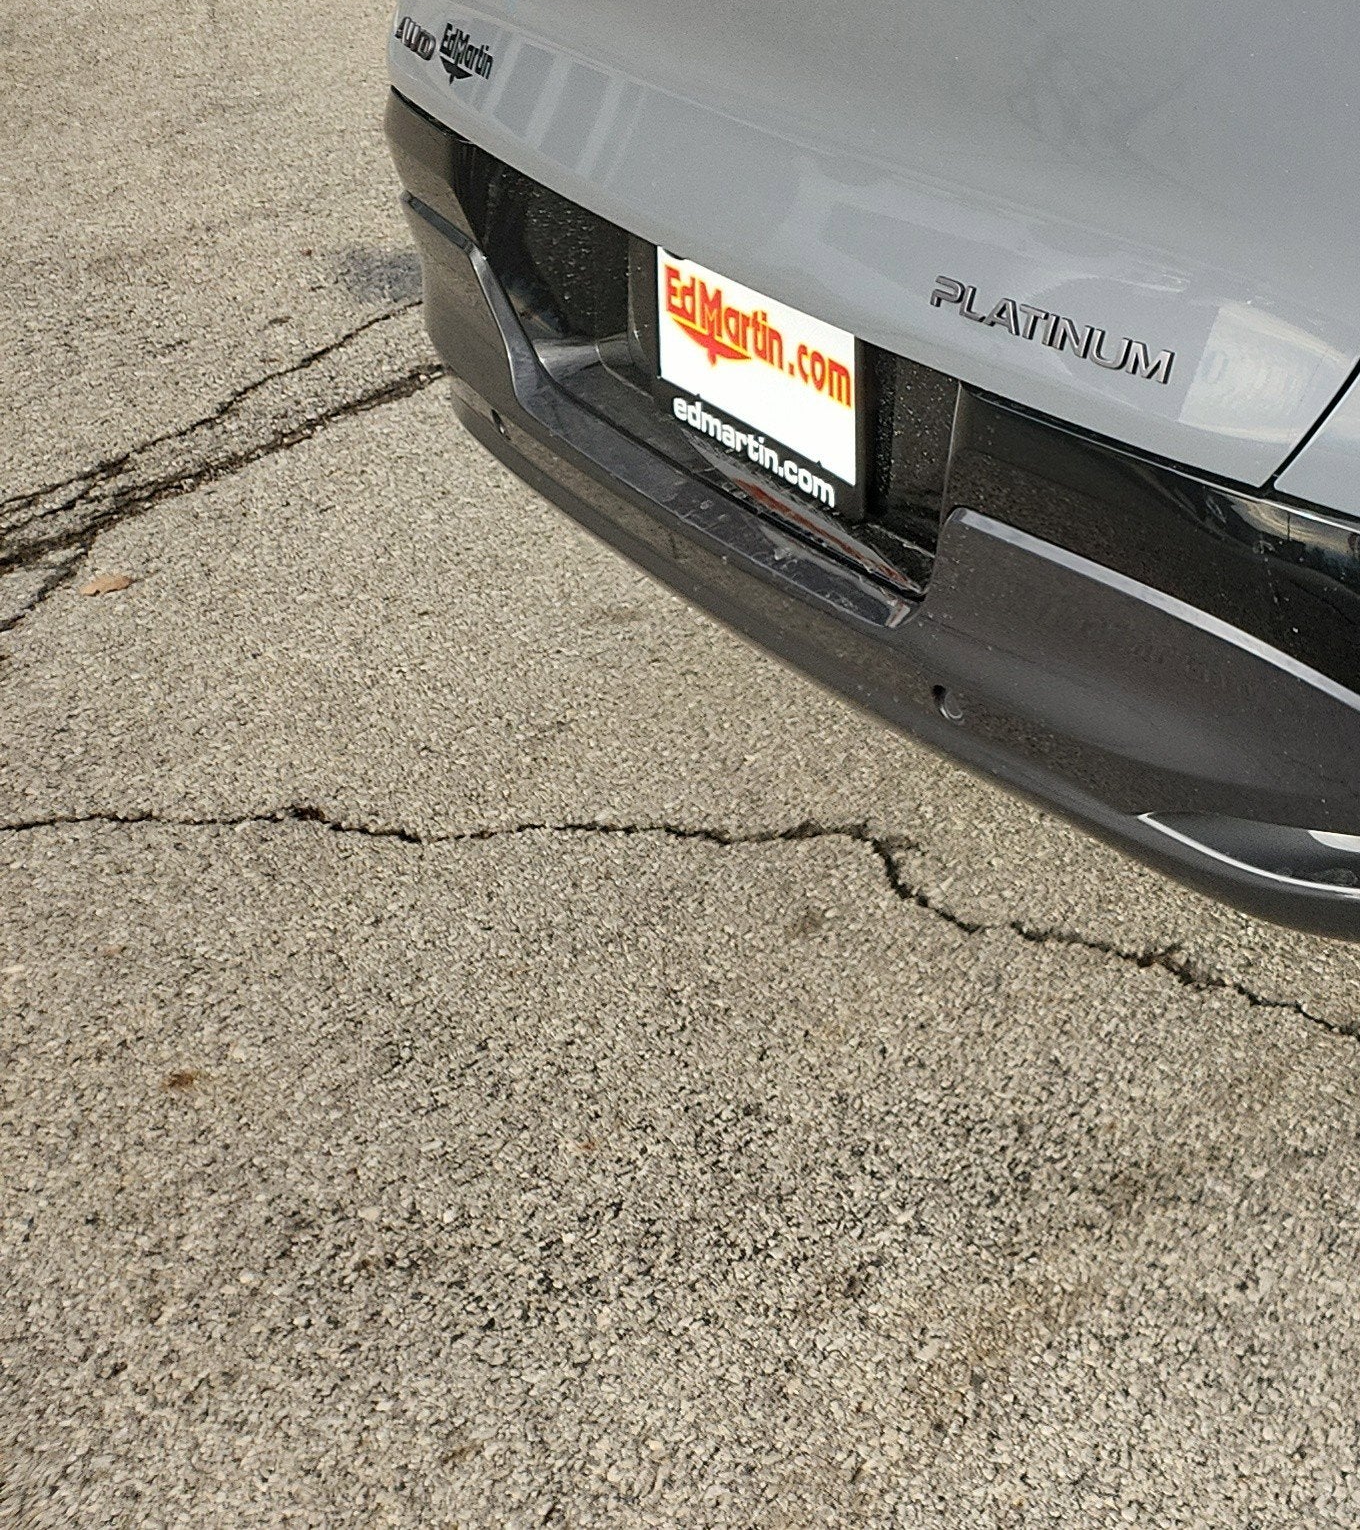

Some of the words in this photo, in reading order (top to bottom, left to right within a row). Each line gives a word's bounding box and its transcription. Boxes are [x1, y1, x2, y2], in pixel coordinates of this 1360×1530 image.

[394, 16, 437, 61] AWD
[440, 22, 494, 79] EdMartin
[930, 275, 1175, 384] PLATINUM
[673, 395, 835, 508] edmartin.com
